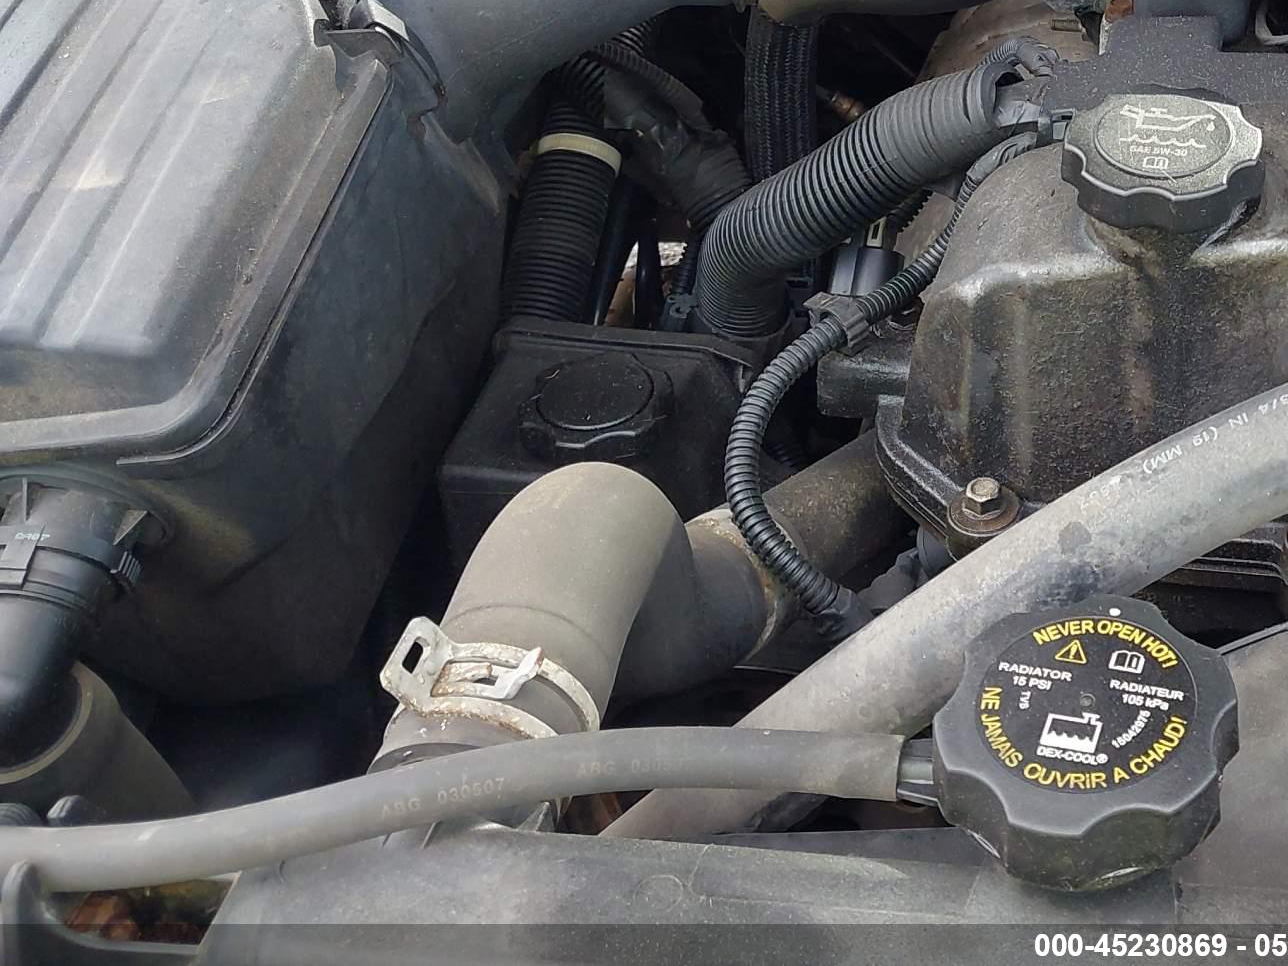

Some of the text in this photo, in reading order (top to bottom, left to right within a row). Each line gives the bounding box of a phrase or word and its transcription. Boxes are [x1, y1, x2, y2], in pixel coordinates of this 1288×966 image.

[1152, 146, 1188, 157] 5W-30
[1228, 411, 1250, 429] IN
[1142, 445, 1183, 476] MM)
[1033, 620, 1179, 669] NEVER OPEN HOT!
[998, 661, 1072, 682] RADIATOR
[1012, 675, 1052, 691] 15 PSI
[1109, 679, 1185, 701] RADIATEUR
[1122, 693, 1169, 711] 105 kPa
[980, 686, 1188, 789] NE JAMAIS OUVRIR A CHAUD!
